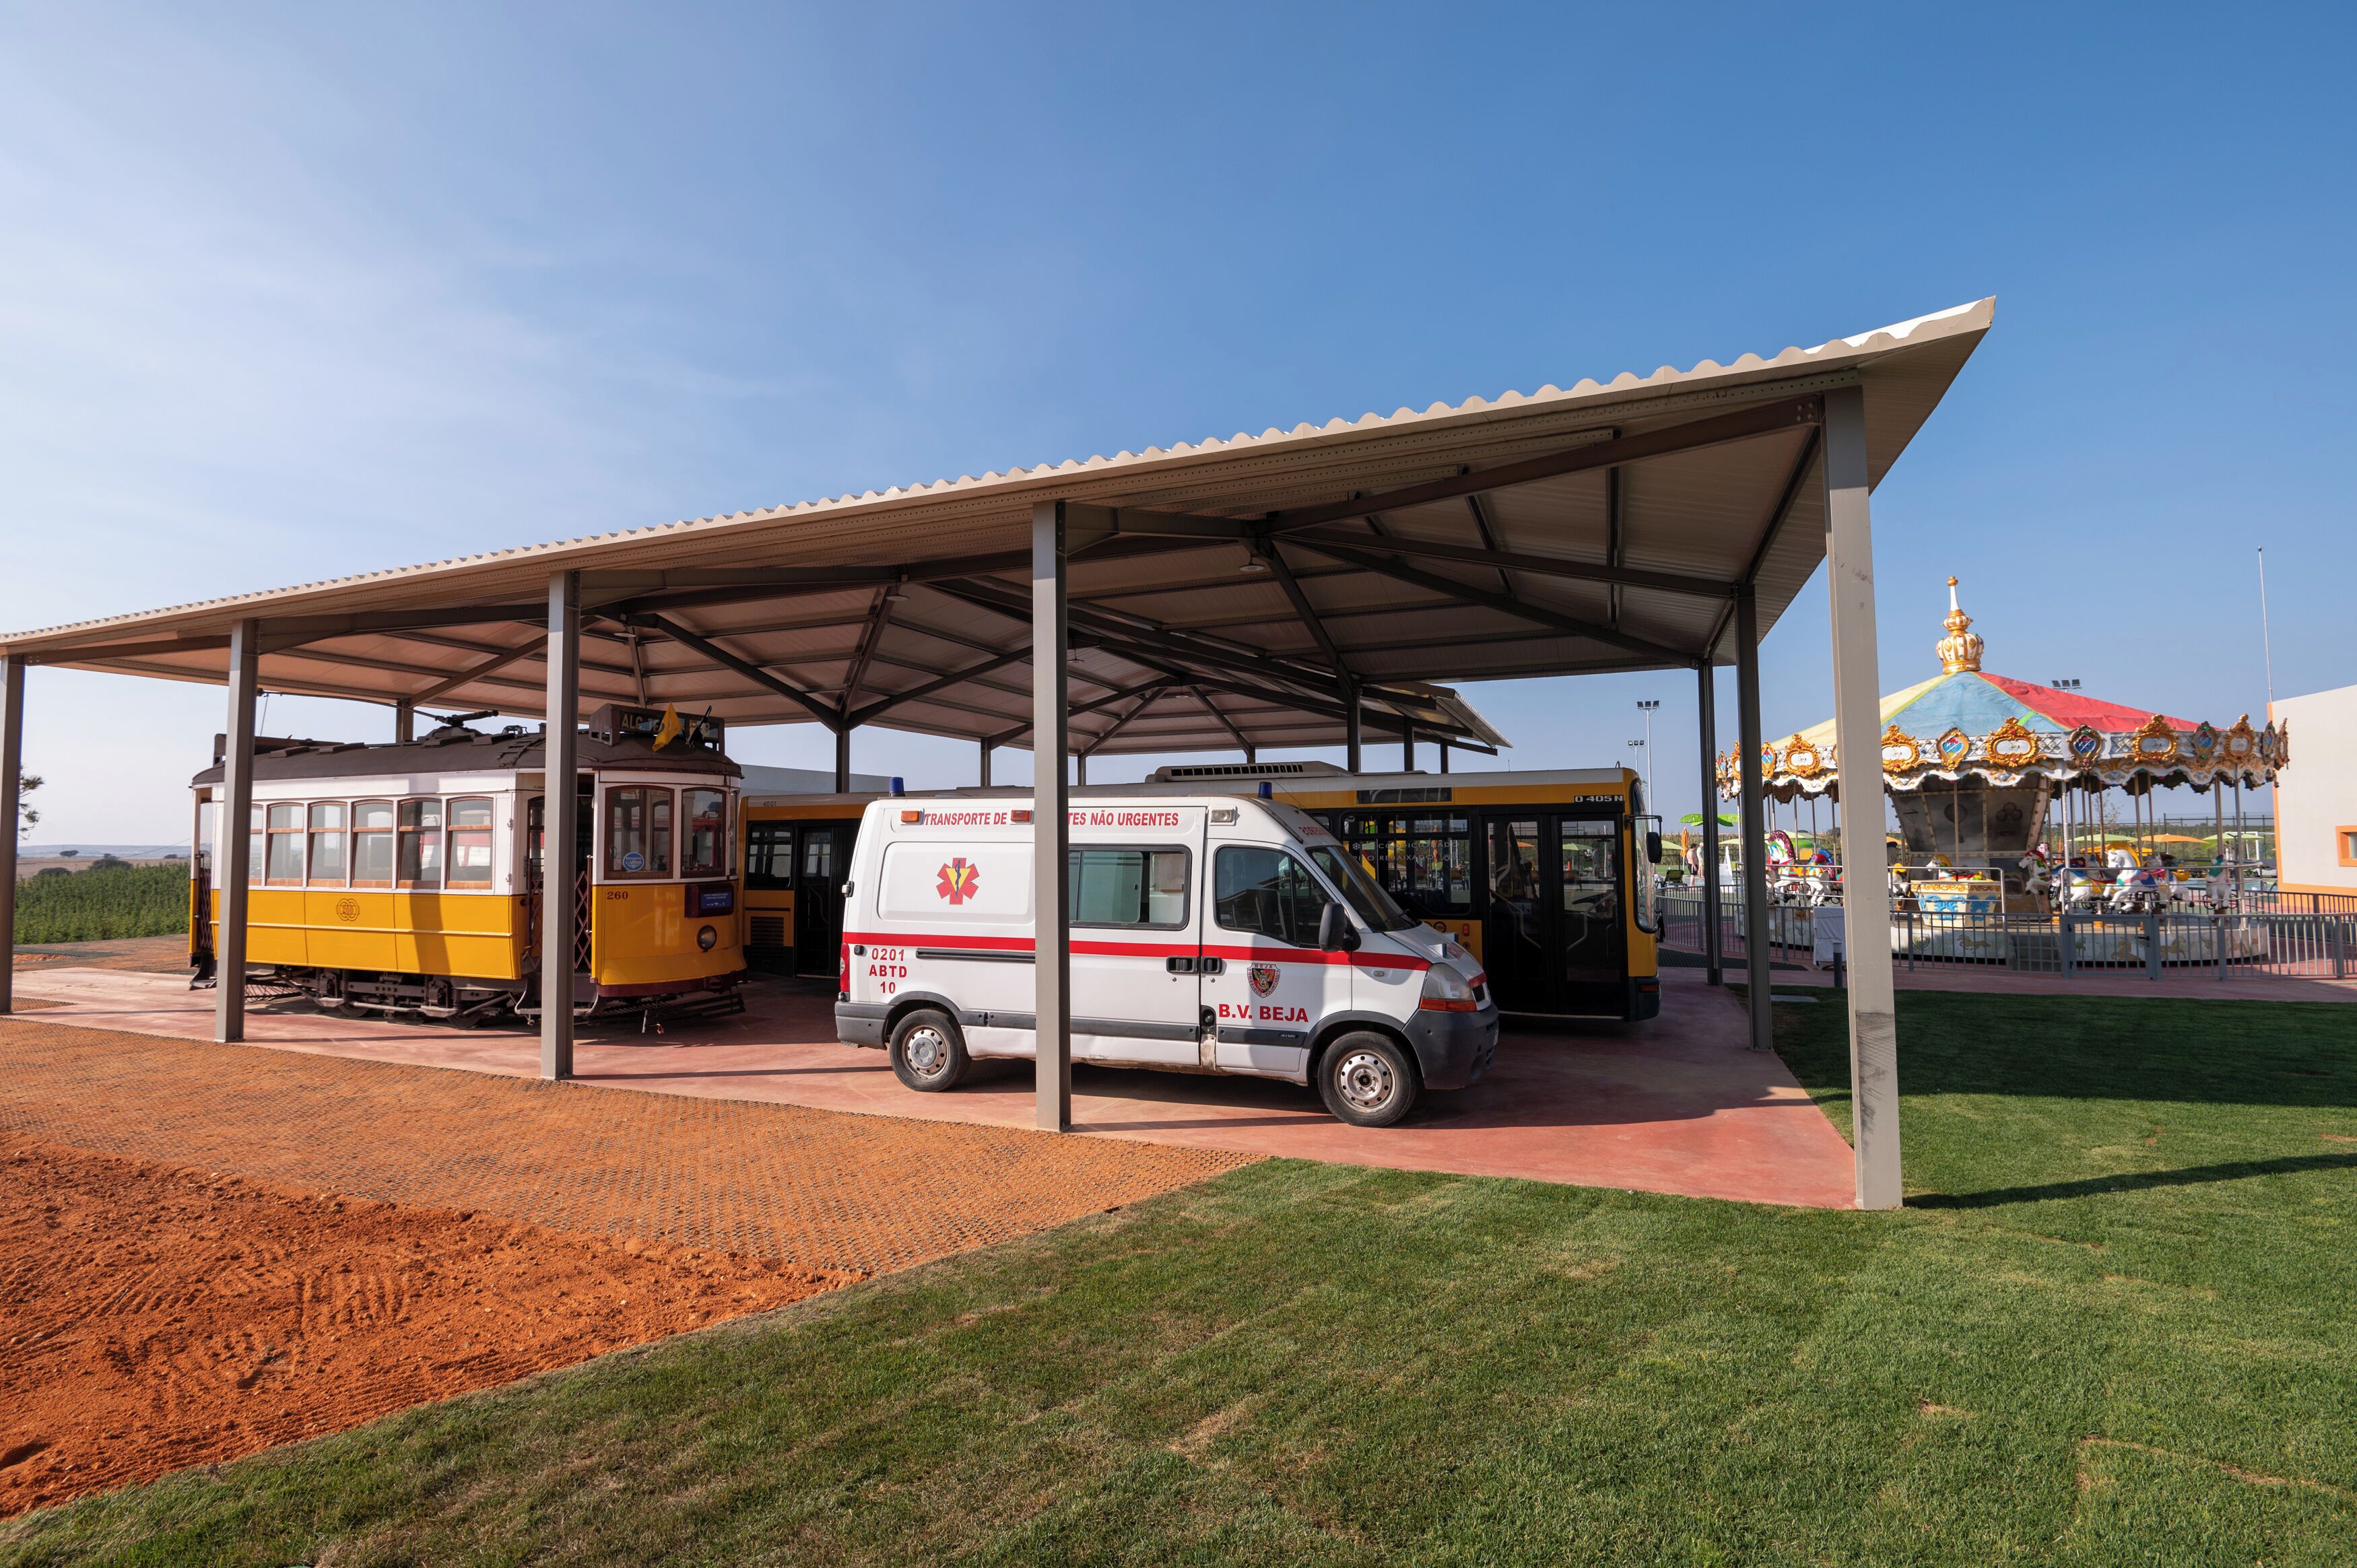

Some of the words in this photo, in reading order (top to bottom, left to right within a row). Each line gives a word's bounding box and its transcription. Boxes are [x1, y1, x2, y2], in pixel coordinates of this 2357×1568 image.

[925, 812, 991, 825] TRANSPORTE
[993, 812, 1008, 825] DE
[1090, 810, 1114, 826] NÃO
[1117, 812, 1179, 826] URGENTES
[607, 891, 628, 900] 260
[871, 947, 904, 961] 0201
[868, 964, 907, 978] ABTD
[880, 981, 896, 994] 10
[1248, 968, 1263, 996] BOMBEIROS
[1218, 1004, 1253, 1019] B.V.
[1259, 1005, 1309, 1023] BEJA
